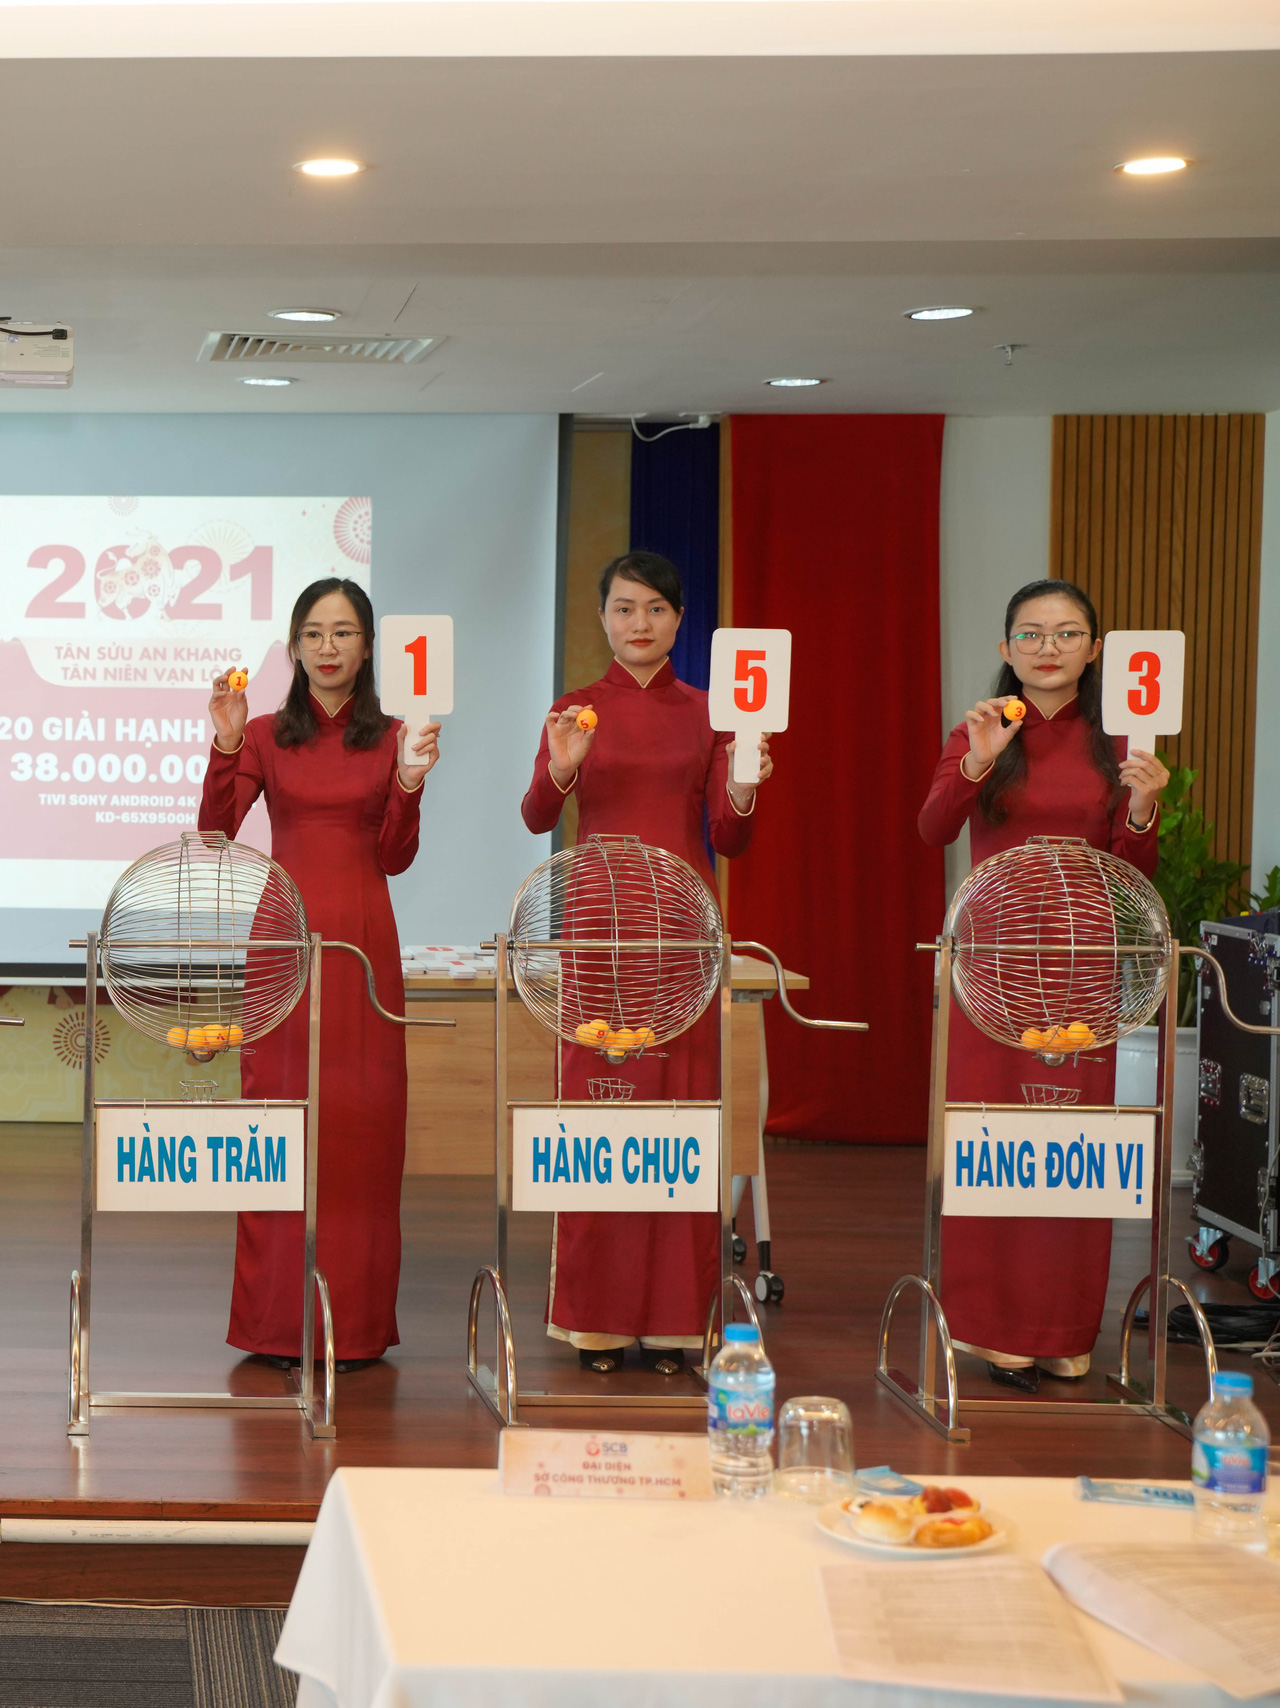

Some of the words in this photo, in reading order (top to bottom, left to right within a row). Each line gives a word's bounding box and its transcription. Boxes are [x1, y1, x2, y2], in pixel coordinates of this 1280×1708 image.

[25, 544, 274, 621] 2021
[54, 643, 90, 661] TÂN
[97, 642, 133, 662] SỬU
[139, 647, 167, 662] AN
[173, 648, 242, 663] KHANG
[404, 635, 427, 696] 1
[61, 664, 97, 681] TÂN
[103, 664, 148, 682] NIÊN
[154, 668, 195, 685] VẠN
[235, 676, 242, 687] 1
[733, 649, 768, 713] 5
[1127, 651, 1161, 716] 3
[580, 719, 590, 729] 5
[1015, 706, 1023, 717] 3
[42, 710, 106, 742] GIẢI
[115, 718, 206, 748] HẠNH
[10, 752, 209, 784] 38.000.00
[38, 793, 66, 806] TIVI
[69, 794, 107, 807] SONY
[110, 795, 175, 808] ANDROID
[177, 796, 197, 808] 4K
[95, 811, 196, 825] KD-65X9500H
[118, 1122, 197, 1183] HÀNG
[206, 1124, 287, 1183] TRĂM
[532, 1123, 612, 1184] HÀNG
[621, 1136, 700, 1198] CHỤC
[956, 1127, 1036, 1189] HÀNG
[1045, 1132, 1106, 1190] ĐƠN
[1116, 1143, 1144, 1205] VỊ
[601, 1442, 628, 1453] SCB
